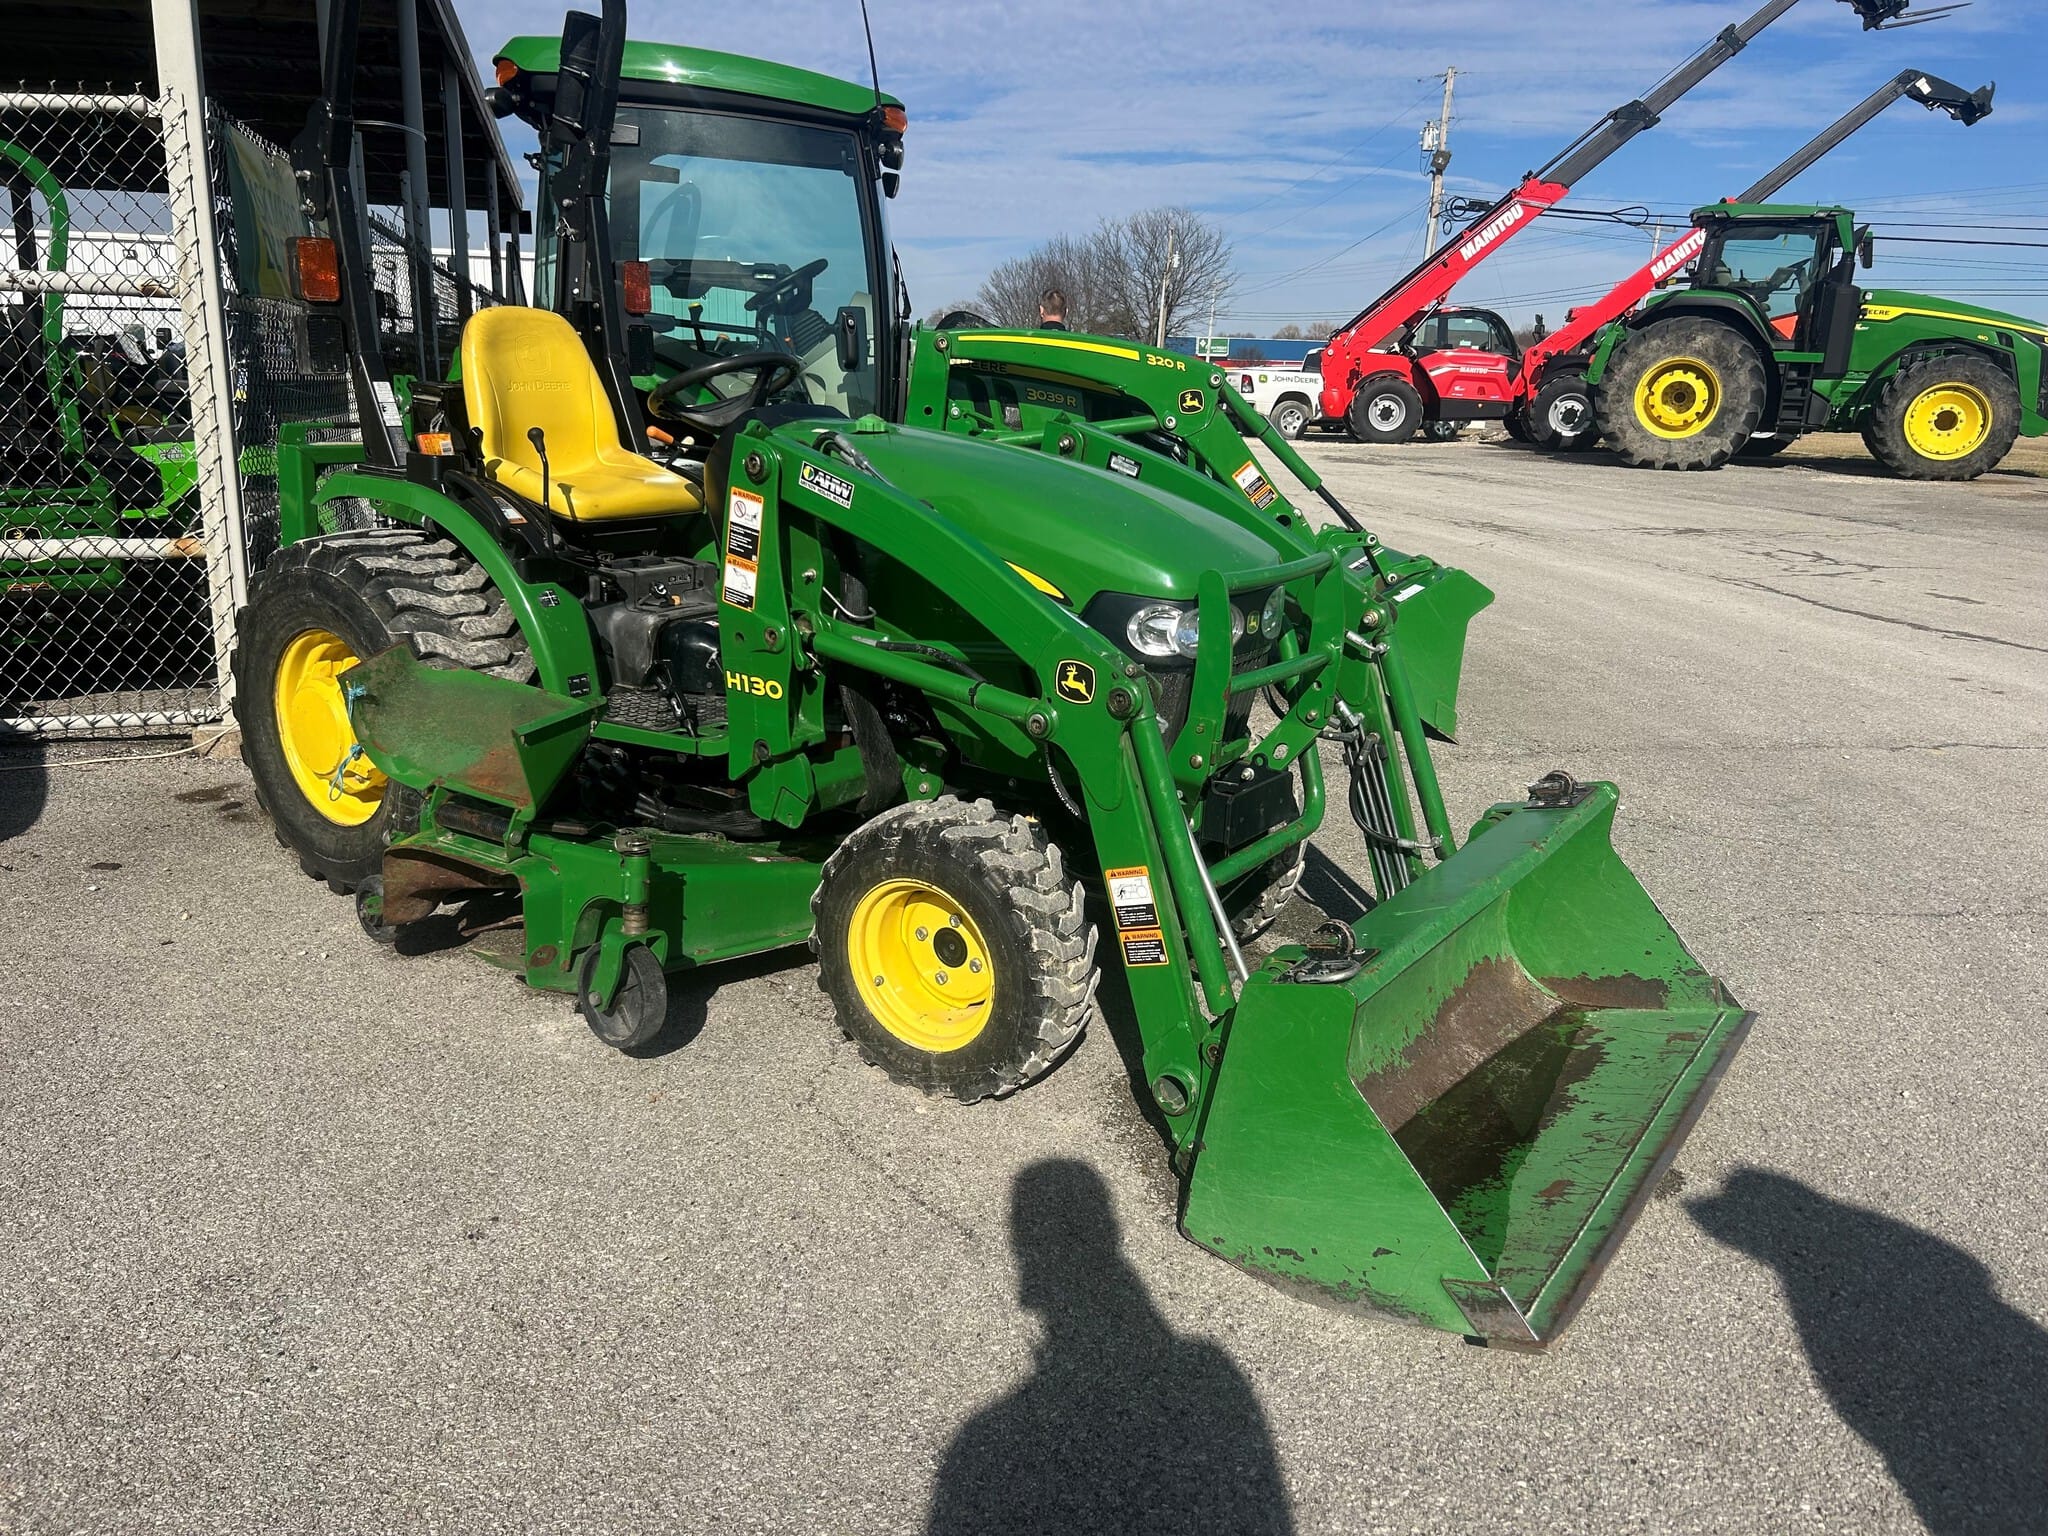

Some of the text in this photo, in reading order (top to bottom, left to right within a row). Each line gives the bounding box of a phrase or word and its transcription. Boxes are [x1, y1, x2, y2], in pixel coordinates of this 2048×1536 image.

[1460, 203, 1524, 261] MANITOU
[1650, 228, 1706, 279] MANITO
[1146, 353, 1187, 372] 320 R
[507, 379, 573, 393] JOHN DEERE
[1272, 375, 1320, 385] JOHN DEERE
[1026, 387, 1077, 407] 3039 R
[812, 472, 852, 499] AHW
[737, 490, 763, 504] WARNING
[732, 559, 756, 573] WARNING
[726, 670, 784, 700] H130
[1117, 868, 1144, 877] WARNING
